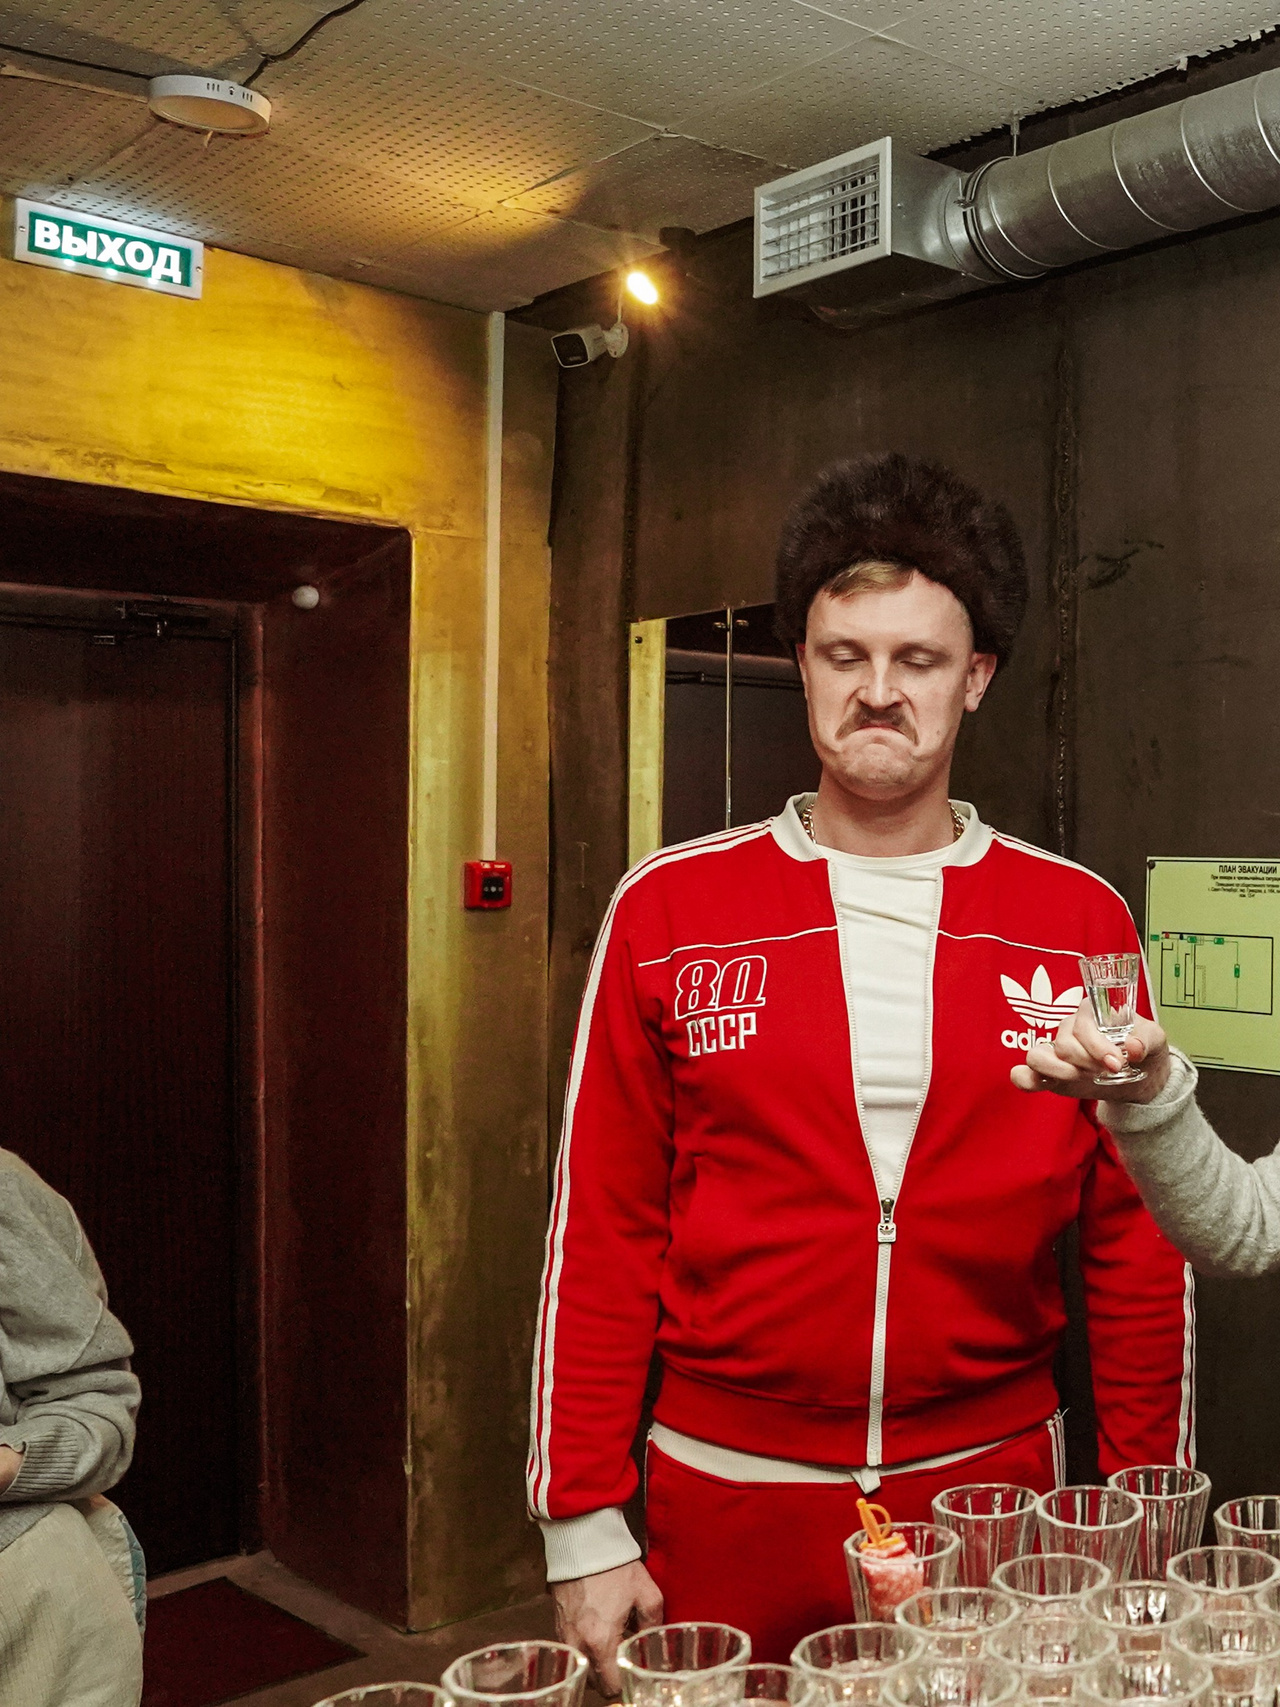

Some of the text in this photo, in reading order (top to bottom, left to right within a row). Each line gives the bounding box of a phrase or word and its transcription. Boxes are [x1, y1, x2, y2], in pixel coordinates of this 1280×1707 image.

[34, 218, 182, 284] ВЫХОД
[1219, 865, 1277, 874] ПЛАН ЭВАКУАЦИИ
[674, 954, 768, 1021] 80
[686, 1012, 758, 1058] СССР
